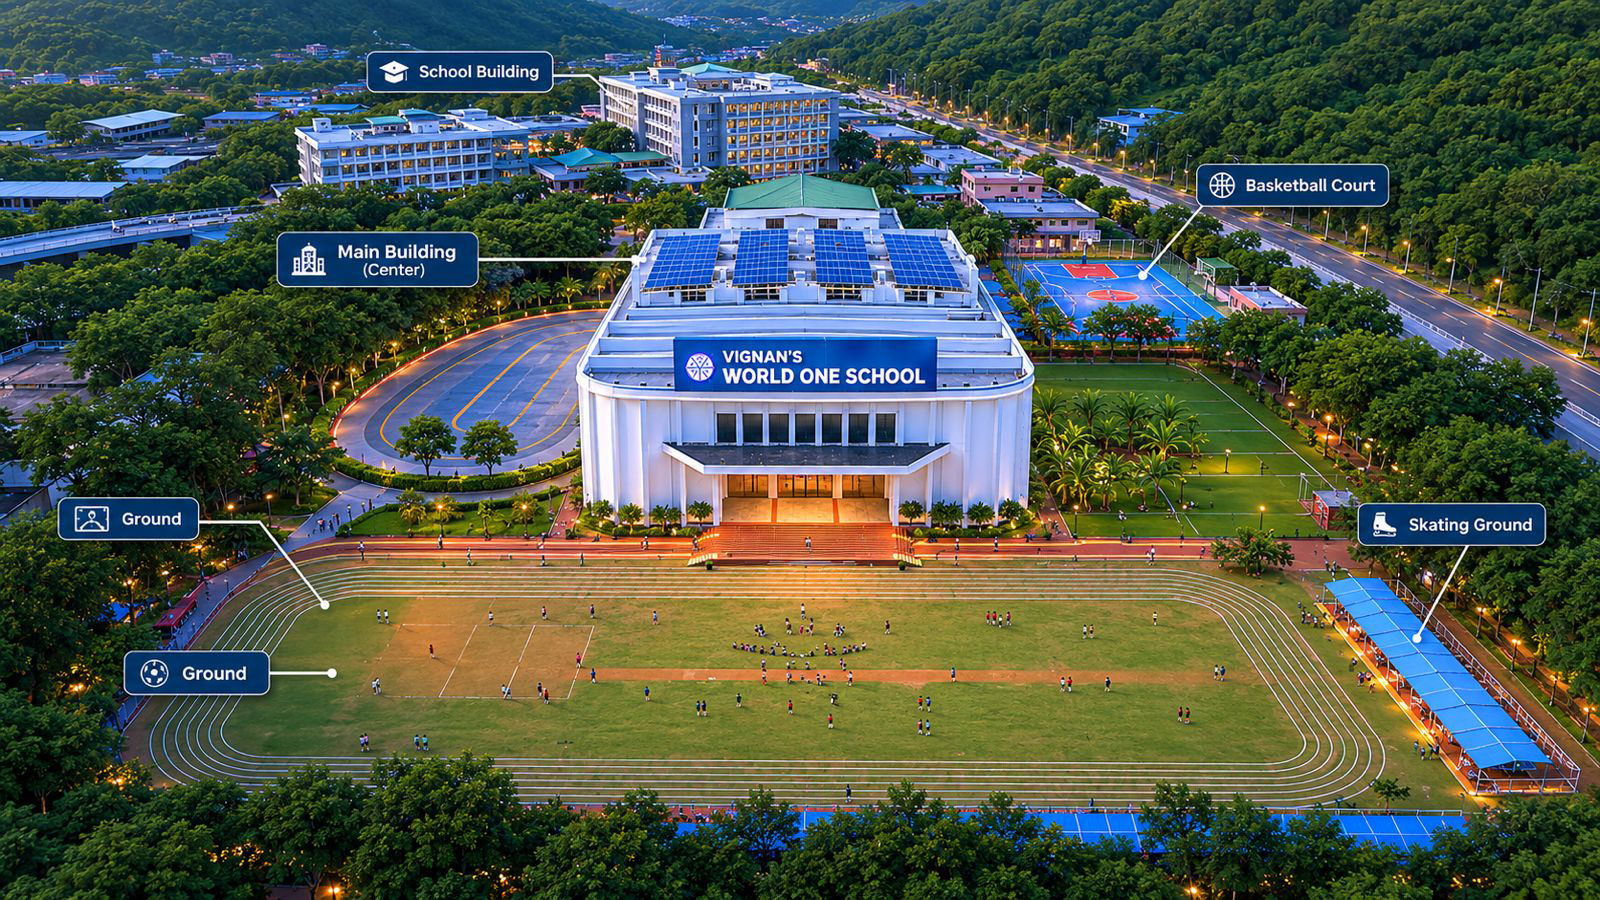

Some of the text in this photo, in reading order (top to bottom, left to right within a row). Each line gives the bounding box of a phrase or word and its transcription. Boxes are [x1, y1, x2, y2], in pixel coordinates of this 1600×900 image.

[722, 350, 803, 364] VIGNAN'S
[722, 367, 926, 385] WORLD ONE SCHOOL
